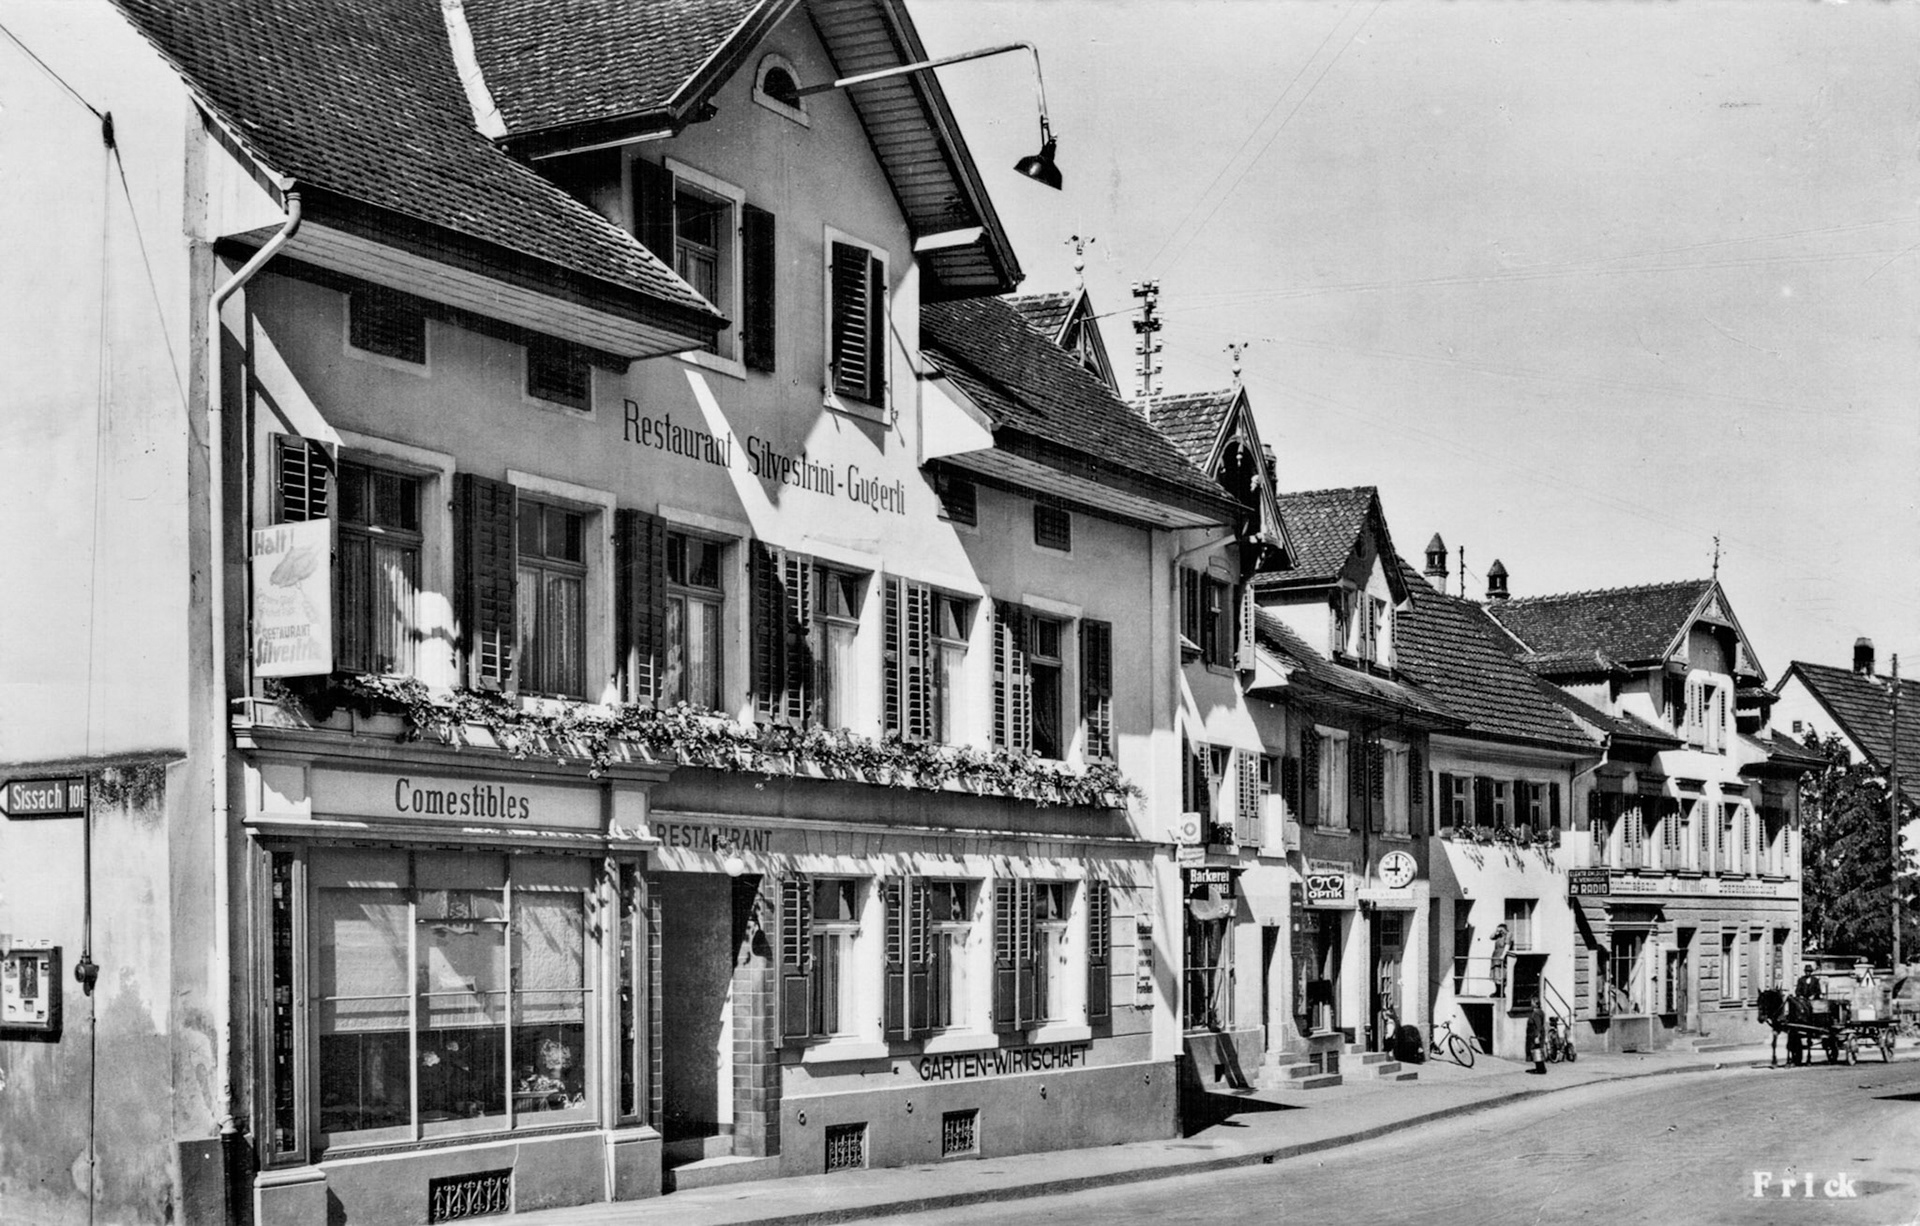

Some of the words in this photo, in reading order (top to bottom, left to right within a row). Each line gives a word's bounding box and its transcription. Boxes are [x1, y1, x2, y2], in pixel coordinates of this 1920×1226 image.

[623, 398, 732, 469] Restaurant
[13, 783, 62, 810] Sissach
[395, 777, 530, 820] Comestibles
[1308, 889, 1342, 898] OPTIK
[1580, 883, 1608, 894] RADIO
[919, 1043, 1088, 1081] GARTEN-WIRTSCHAFT
